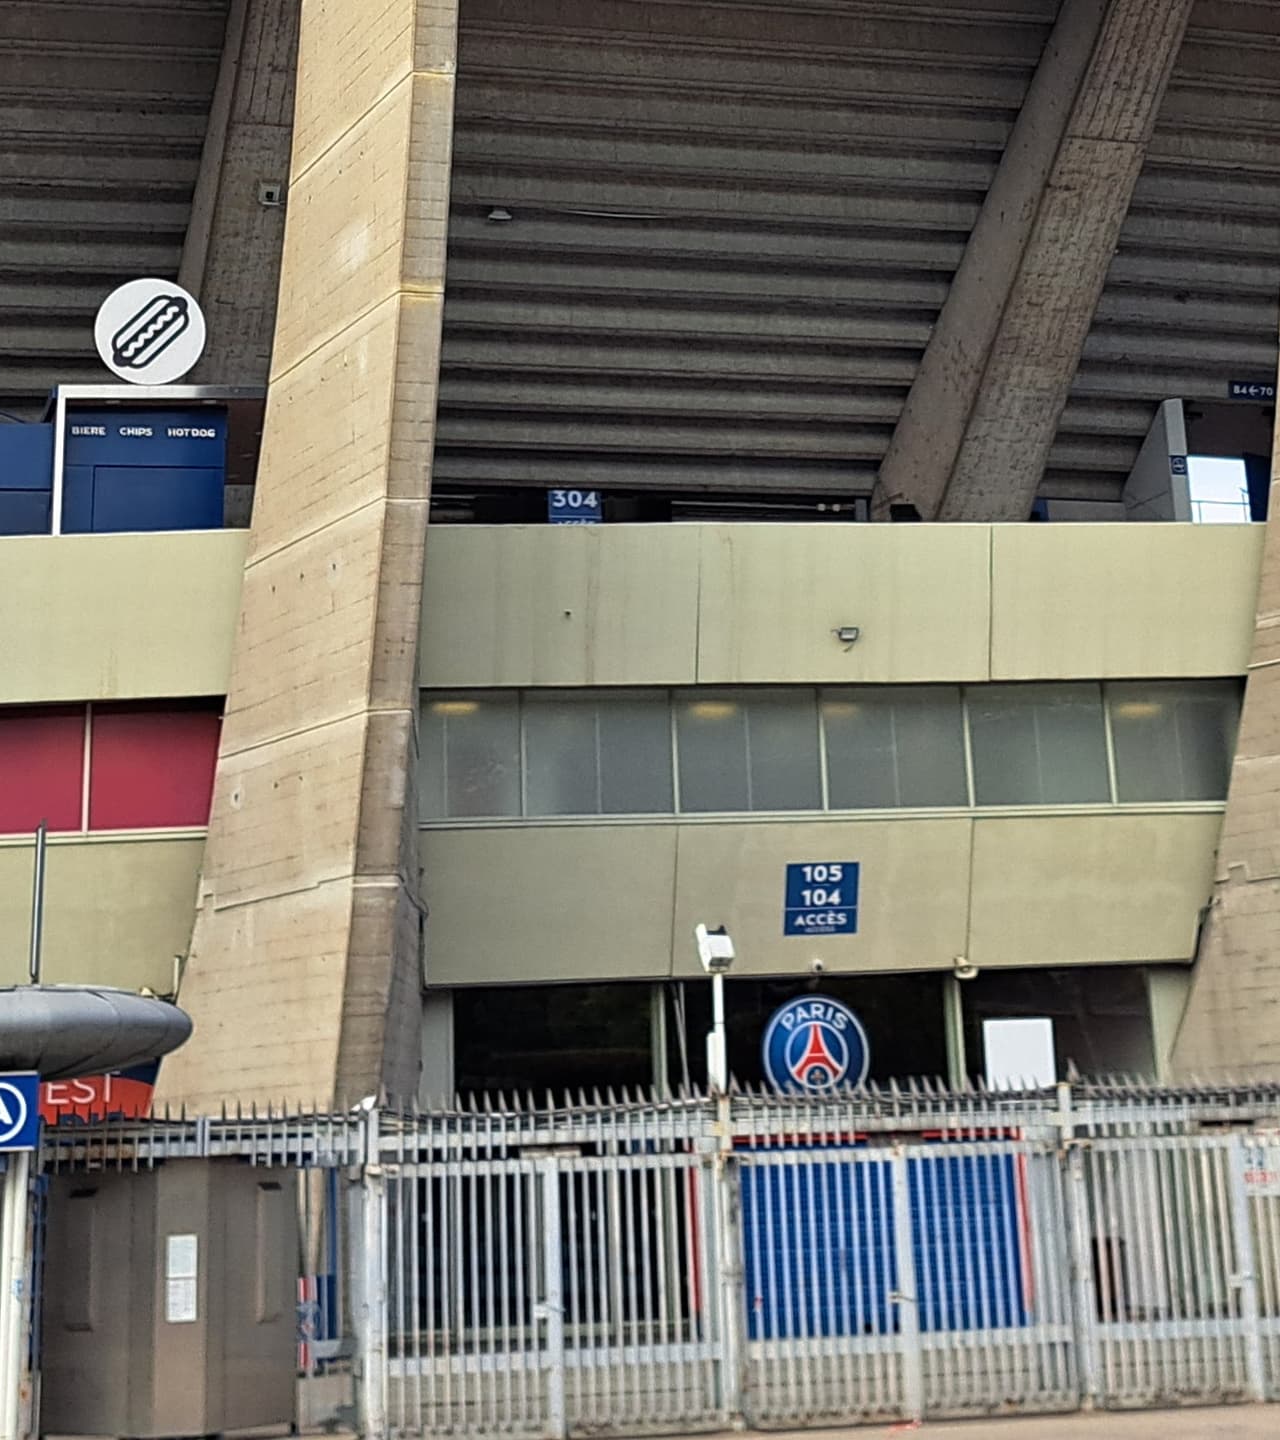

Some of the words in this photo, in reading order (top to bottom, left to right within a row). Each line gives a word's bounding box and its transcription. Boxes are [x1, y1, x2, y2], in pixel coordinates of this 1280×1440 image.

[1259, 386, 1273, 397] 70
[118, 426, 154, 437] CHIPS
[552, 490, 598, 508] 304
[802, 864, 842, 883] 105
[801, 888, 841, 907] 104
[793, 910, 847, 927] ACCÈS
[780, 1003, 848, 1031] PARIS
